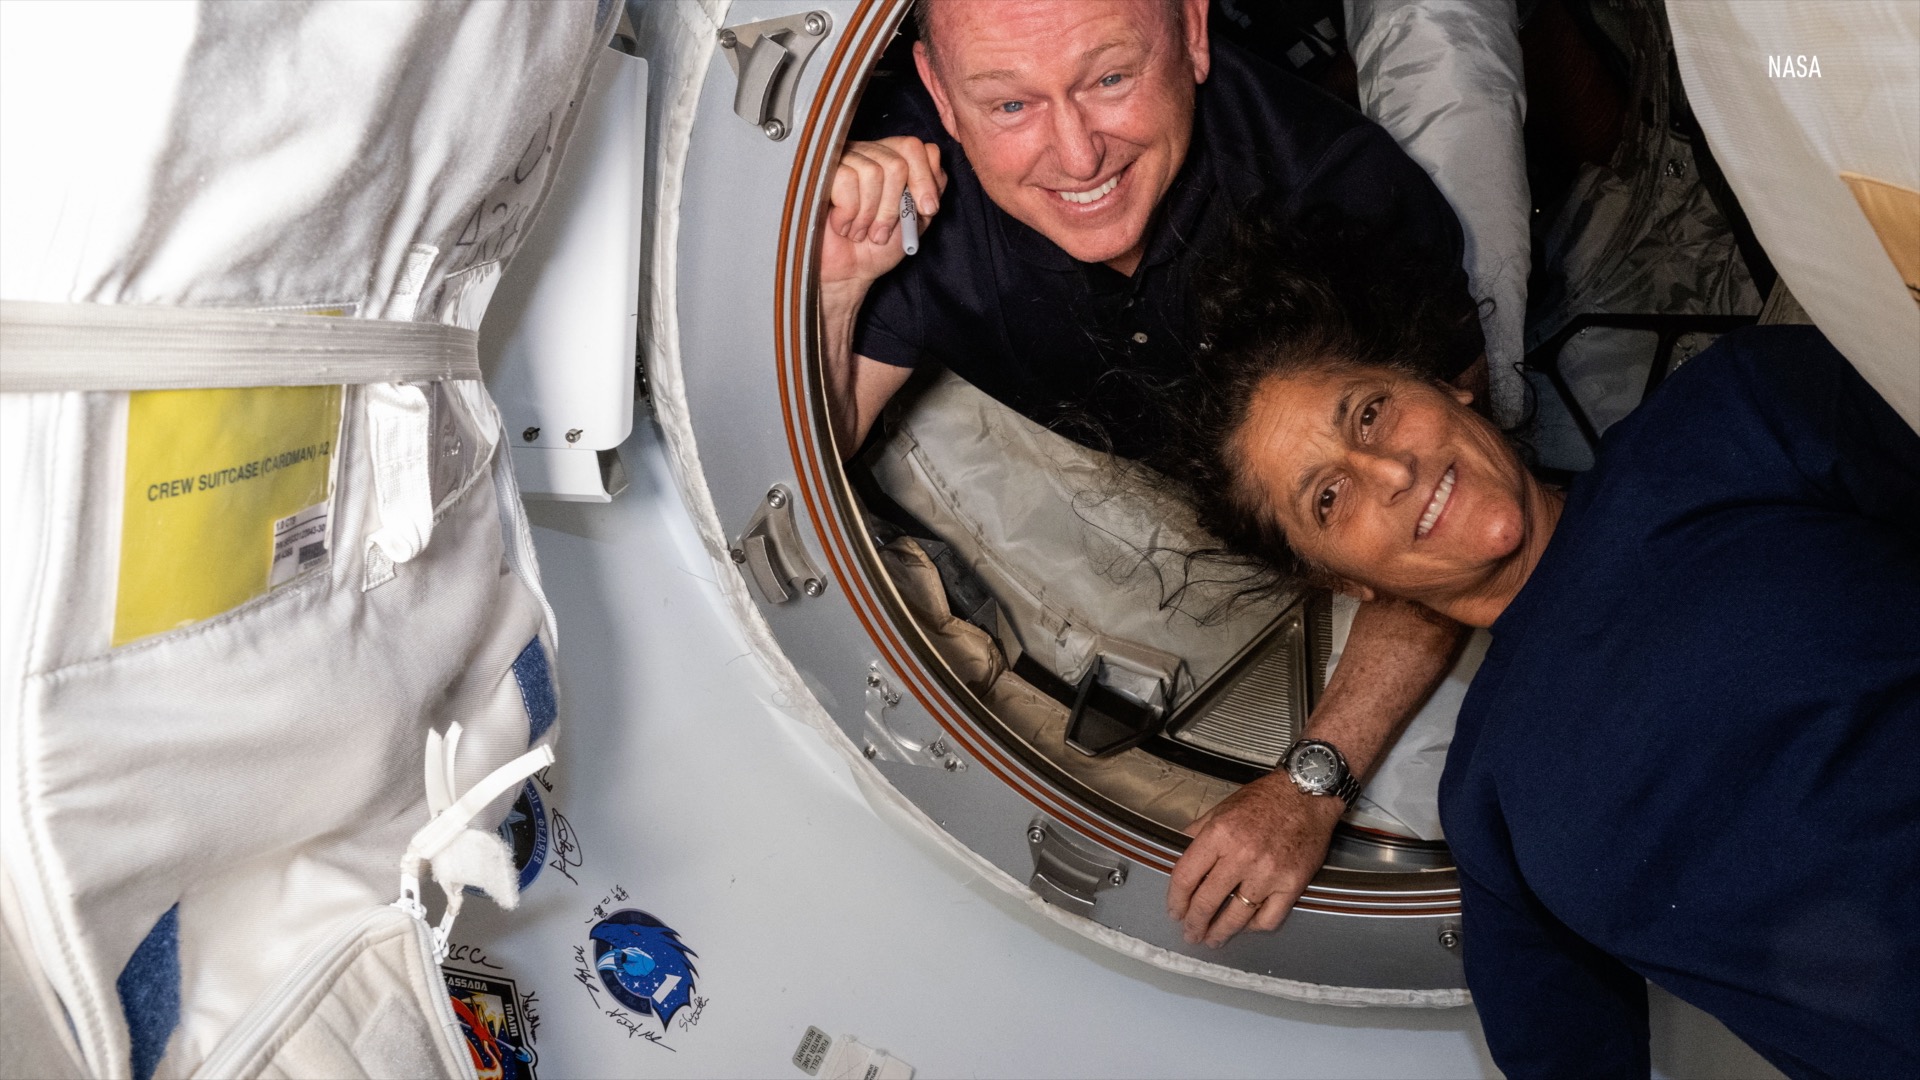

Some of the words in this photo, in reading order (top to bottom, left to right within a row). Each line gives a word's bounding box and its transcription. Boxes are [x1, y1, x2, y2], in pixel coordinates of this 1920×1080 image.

[147, 477, 195, 502] CREW
[198, 461, 259, 491] SUITCASE
[261, 443, 317, 477] (CARDMAN)
[533, 817, 548, 866] ФЕДЯЕВ
[505, 1003, 519, 1038] MANN
[795, 1029, 817, 1063] RESTRAINT
[808, 1033, 824, 1054] WATER
[818, 1039, 829, 1055] FUEL
[802, 1053, 813, 1069] LINE
[810, 1055, 822, 1070] CELL
